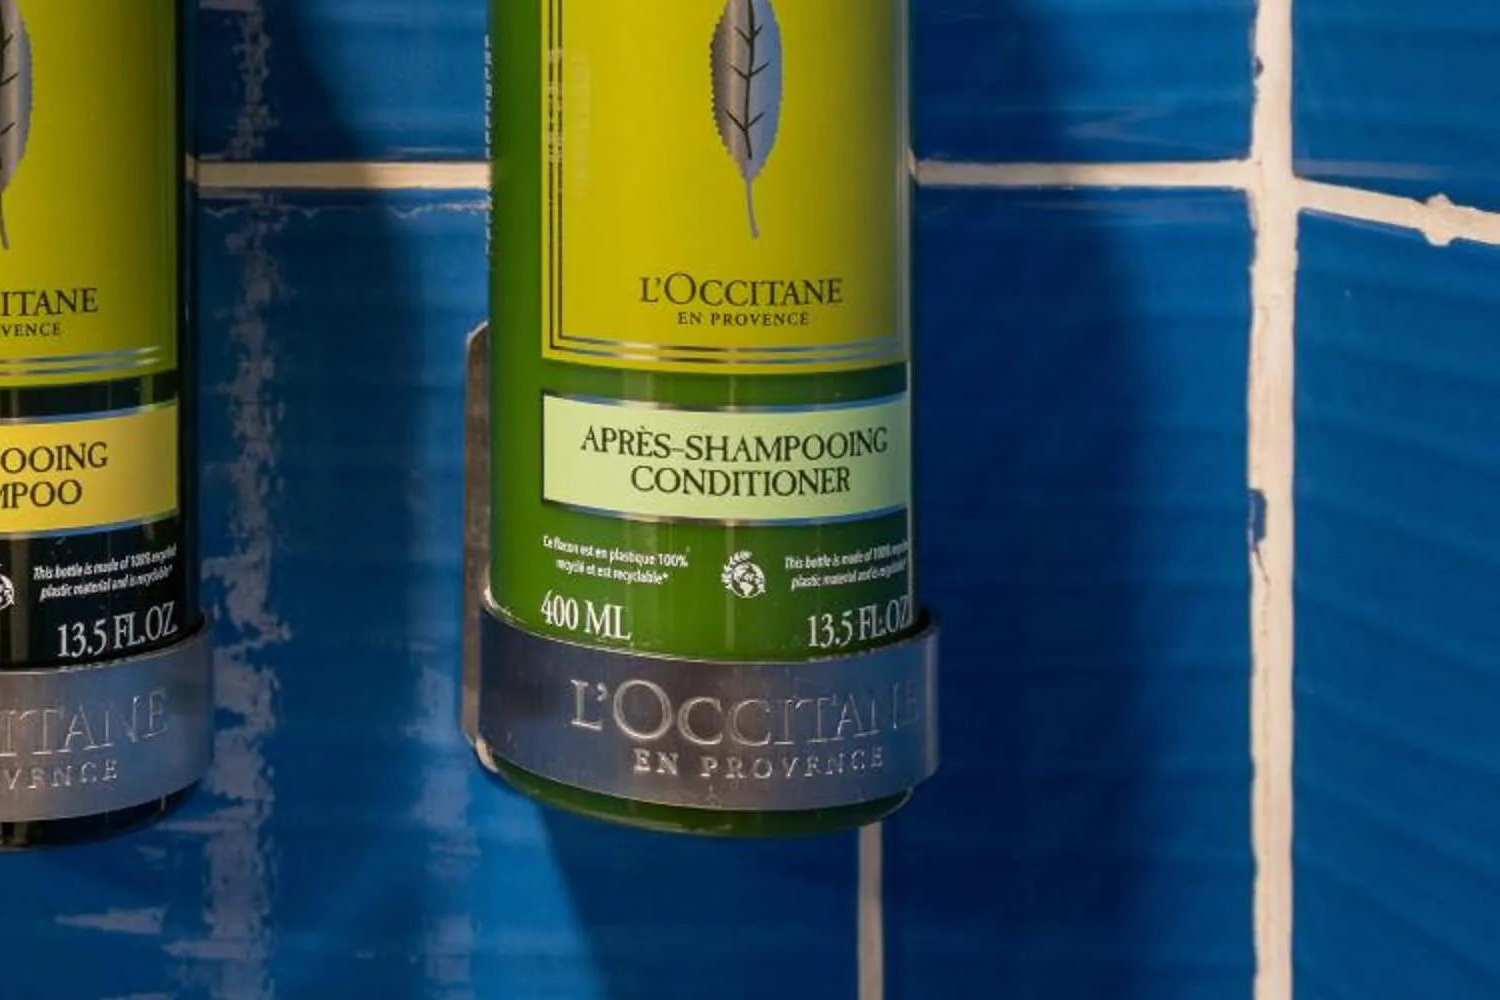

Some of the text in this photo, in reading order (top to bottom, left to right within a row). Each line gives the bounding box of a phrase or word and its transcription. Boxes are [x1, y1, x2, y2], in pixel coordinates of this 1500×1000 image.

[639, 273, 843, 306] L'OCCITANE
[677, 310, 809, 327] EN PROVENCE
[580, 425, 888, 463] APRÈS-SHAMPOOING
[630, 465, 851, 497] CONDITIONER
[33, 565, 53, 580] This
[54, 563, 83, 579] bottle
[84, 562, 93, 575] is
[595, 548, 607, 559] en
[609, 547, 655, 567] plastique
[658, 553, 689, 568] 100%
[40, 583, 72, 601] plastic
[540, 590, 633, 641] 400 ML
[807, 610, 853, 648] 13.5
[57, 619, 107, 657] 13.5
[632, 746, 885, 780] EN PROVENCE
